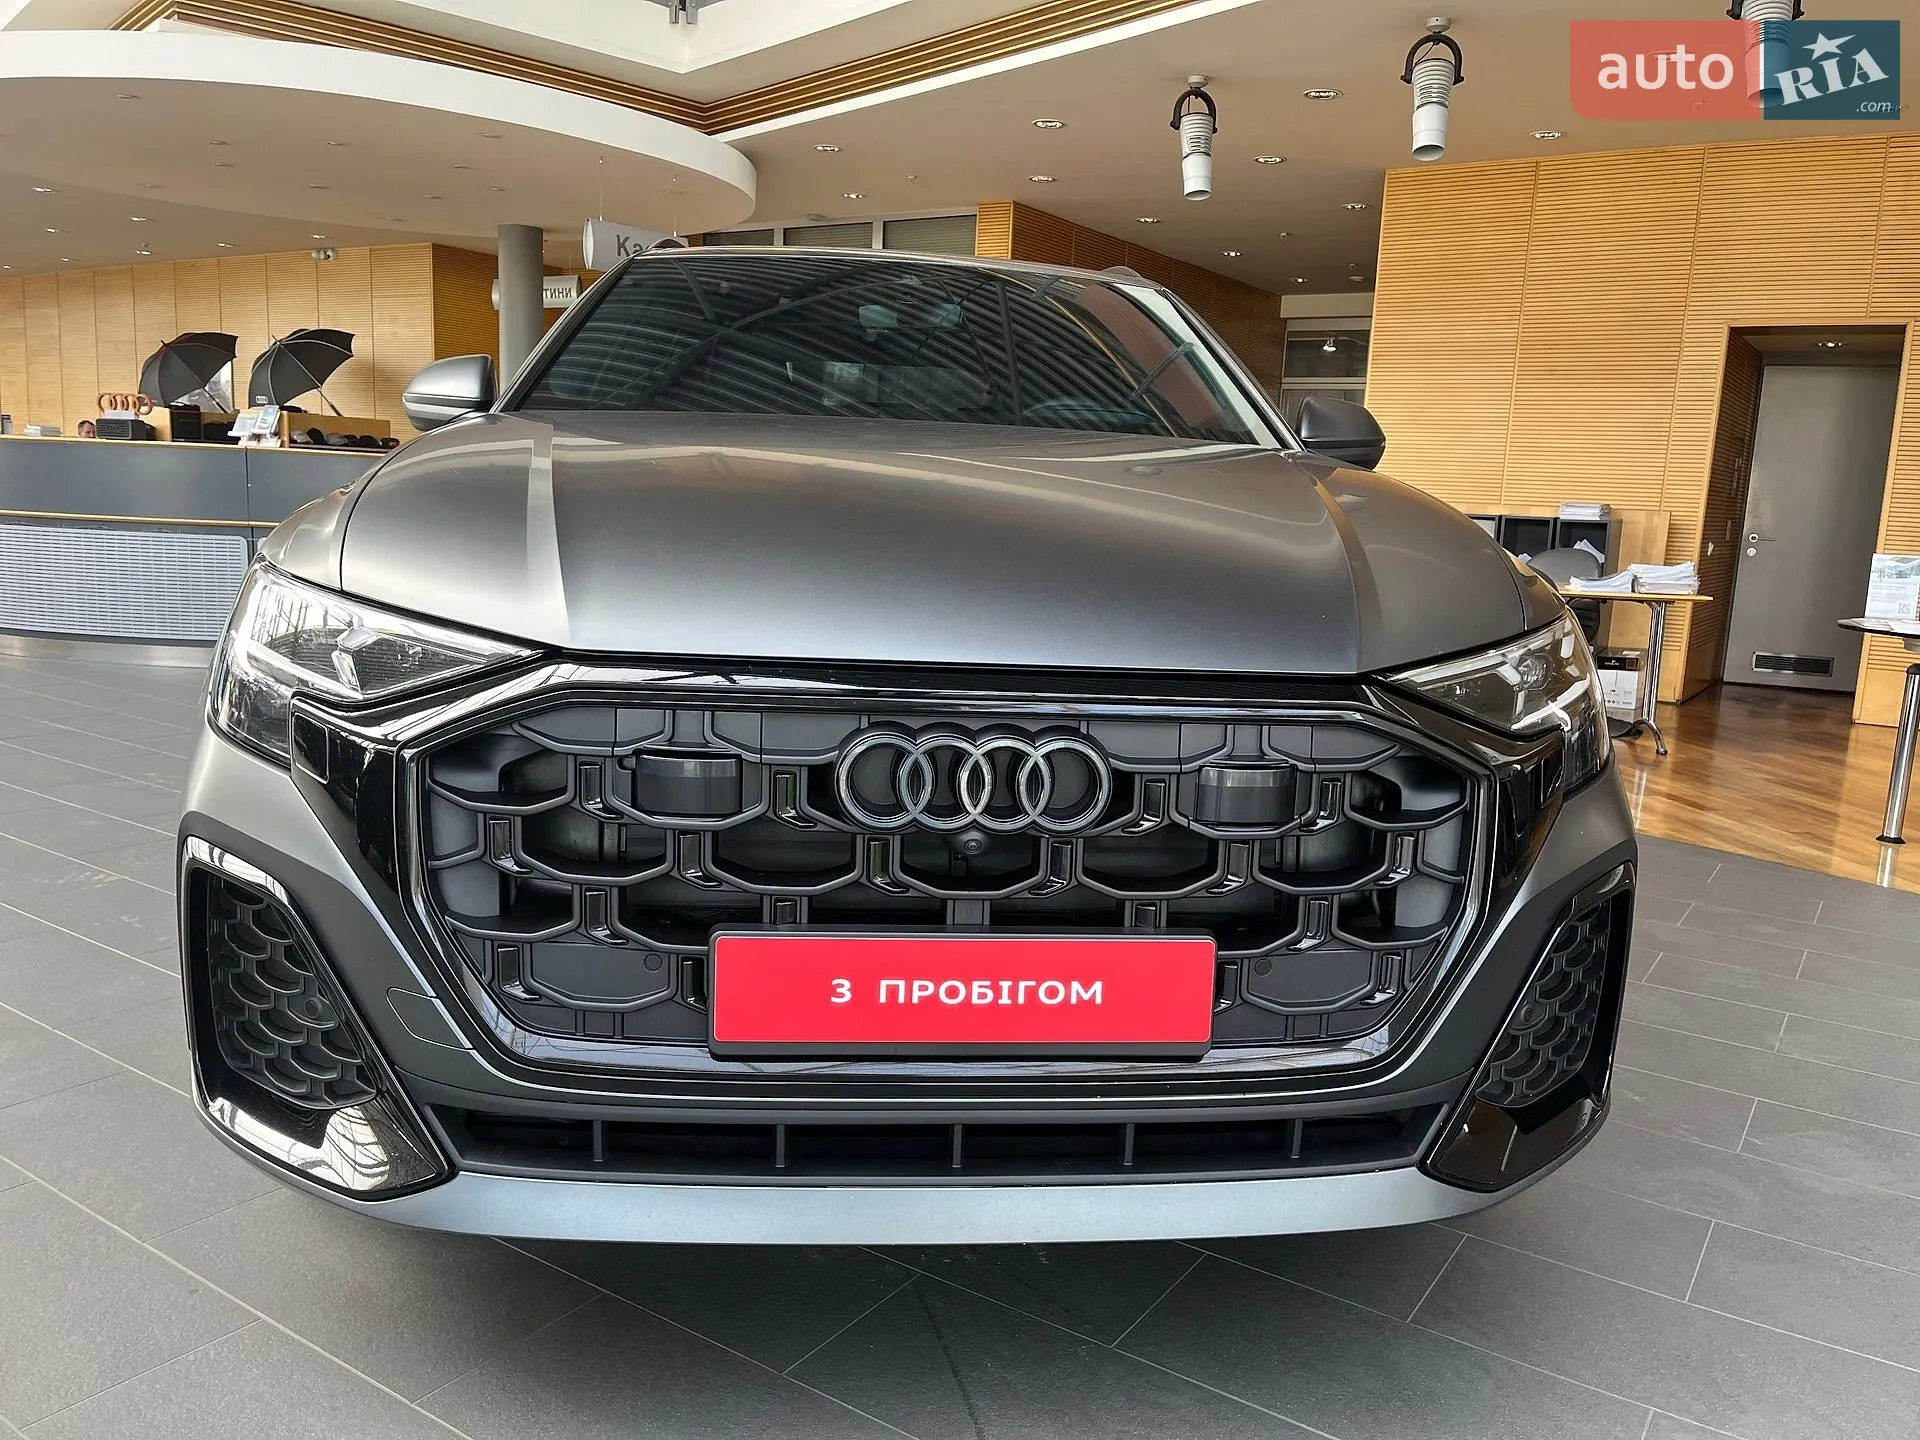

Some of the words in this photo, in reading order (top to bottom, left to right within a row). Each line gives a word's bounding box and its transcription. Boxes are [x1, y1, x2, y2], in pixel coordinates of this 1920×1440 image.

[616, 234, 650, 257] Ка
[543, 287, 572, 299] тини
[878, 979, 1103, 1005] ПРОБІГОМ
